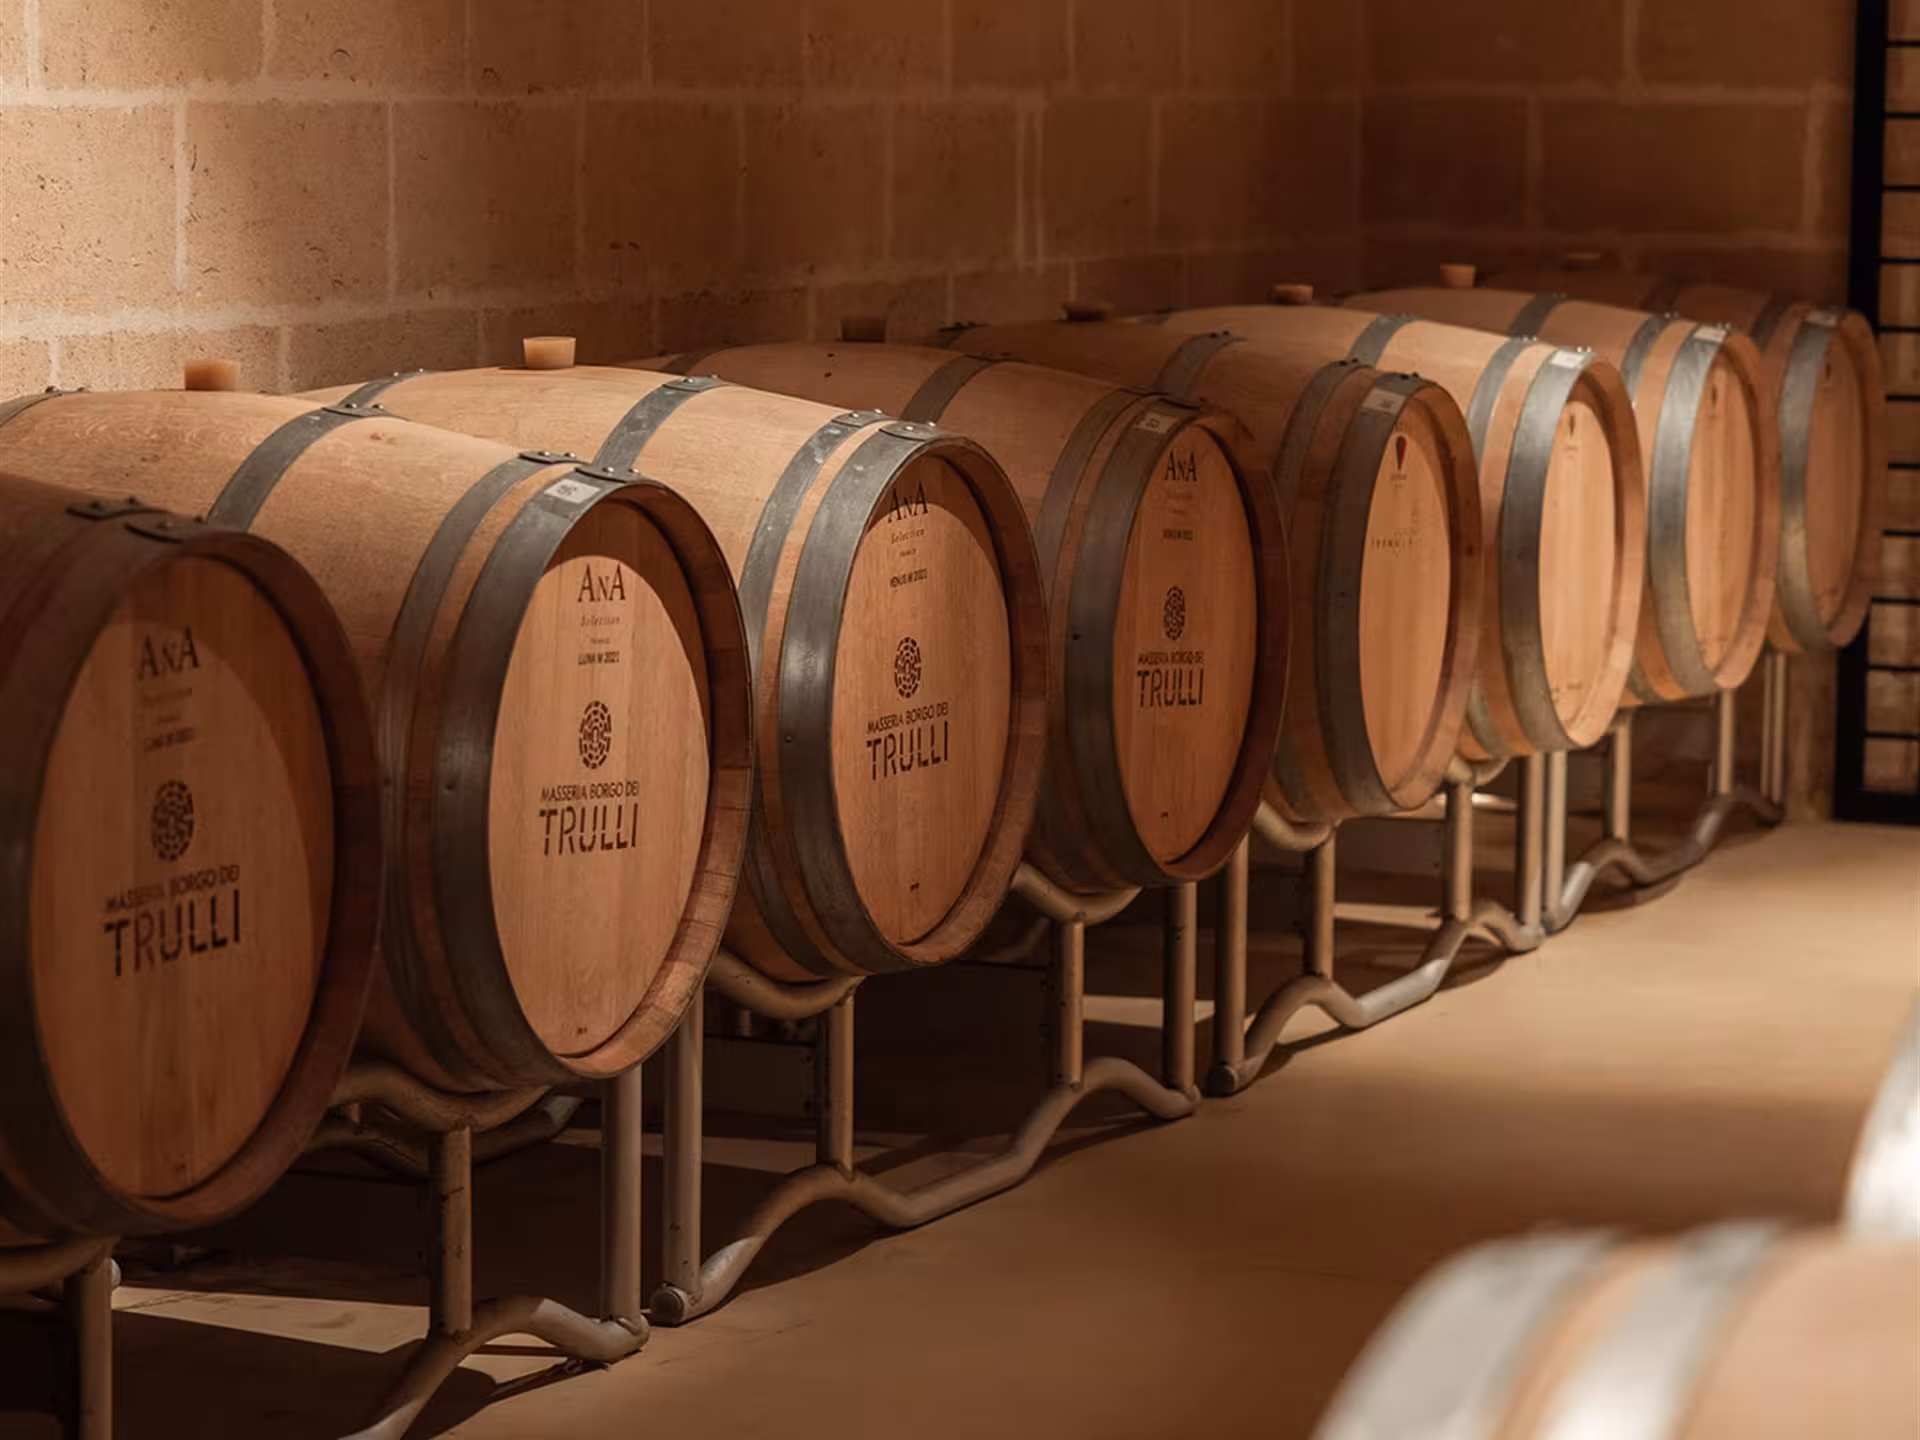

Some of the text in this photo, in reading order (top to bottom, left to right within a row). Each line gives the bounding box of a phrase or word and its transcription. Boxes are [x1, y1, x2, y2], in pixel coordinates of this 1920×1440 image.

[1137, 668, 1204, 708] TRULLI
[866, 714, 903, 735] MASSERIA
[905, 704, 935, 726] BORGO
[866, 720, 948, 782] TRULLI
[541, 784, 587, 801] MASSERIA
[590, 782, 624, 800] BORGO
[539, 802, 638, 857] TRULLI
[104, 888, 241, 977] TRULLI
